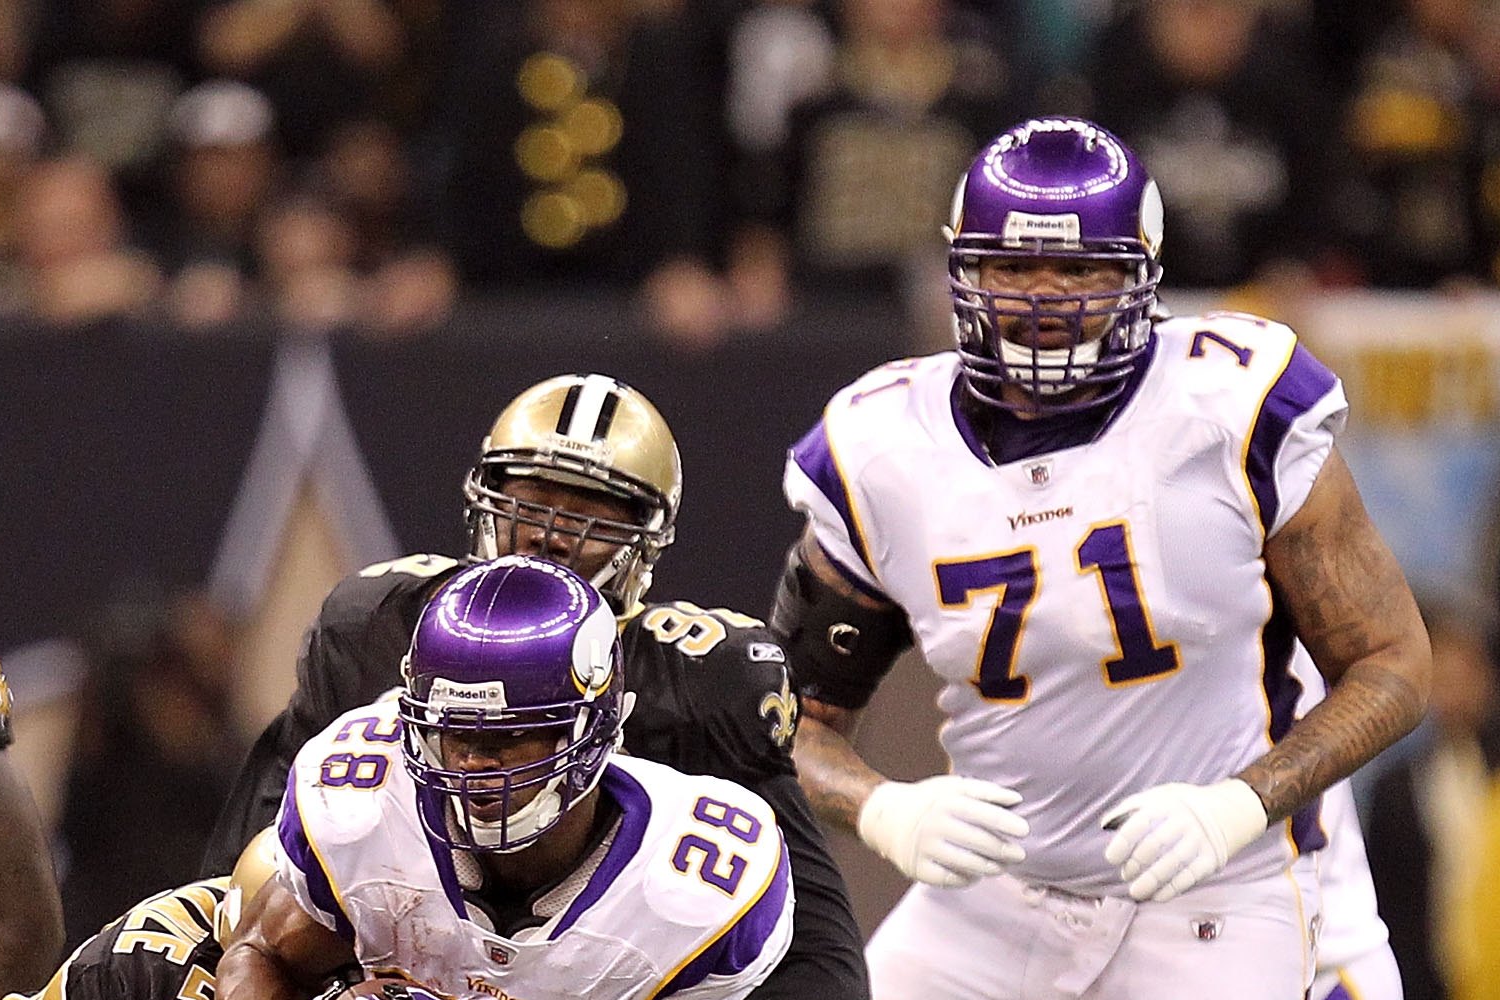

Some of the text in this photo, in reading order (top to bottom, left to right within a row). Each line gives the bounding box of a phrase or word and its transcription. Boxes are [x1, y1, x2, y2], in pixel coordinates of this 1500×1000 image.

[931, 518, 1185, 706] 71
[448, 687, 487, 699] Riddell
[331, 715, 405, 792] 28
[668, 795, 764, 900] 28
